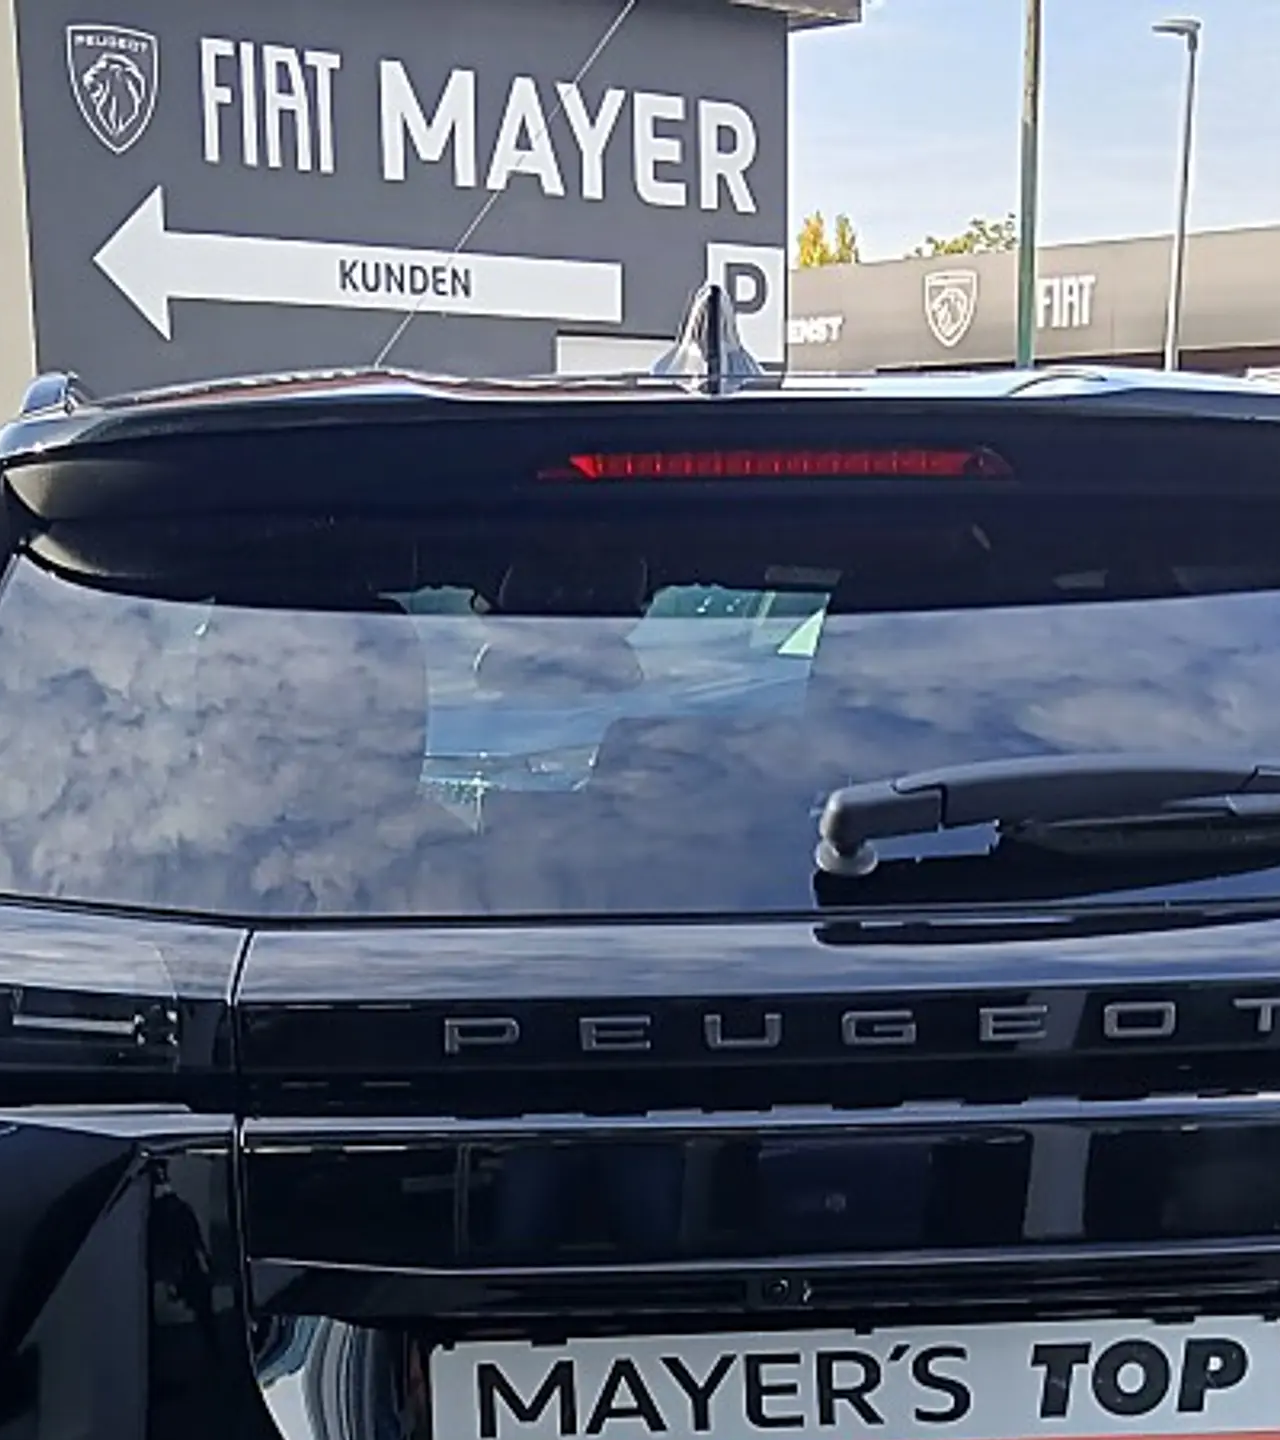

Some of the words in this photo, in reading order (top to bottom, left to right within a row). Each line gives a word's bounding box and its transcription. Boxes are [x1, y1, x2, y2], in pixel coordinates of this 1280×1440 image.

[74, 34, 148, 52] PEUGEOT
[201, 36, 342, 174] FIAT
[379, 59, 758, 214] MAYER
[338, 257, 472, 298] KUNDEN
[724, 262, 767, 314] P
[1035, 274, 1097, 328] FIAT
[787, 315, 844, 344] ENST
[1031, 1337, 1250, 1419] TOP
